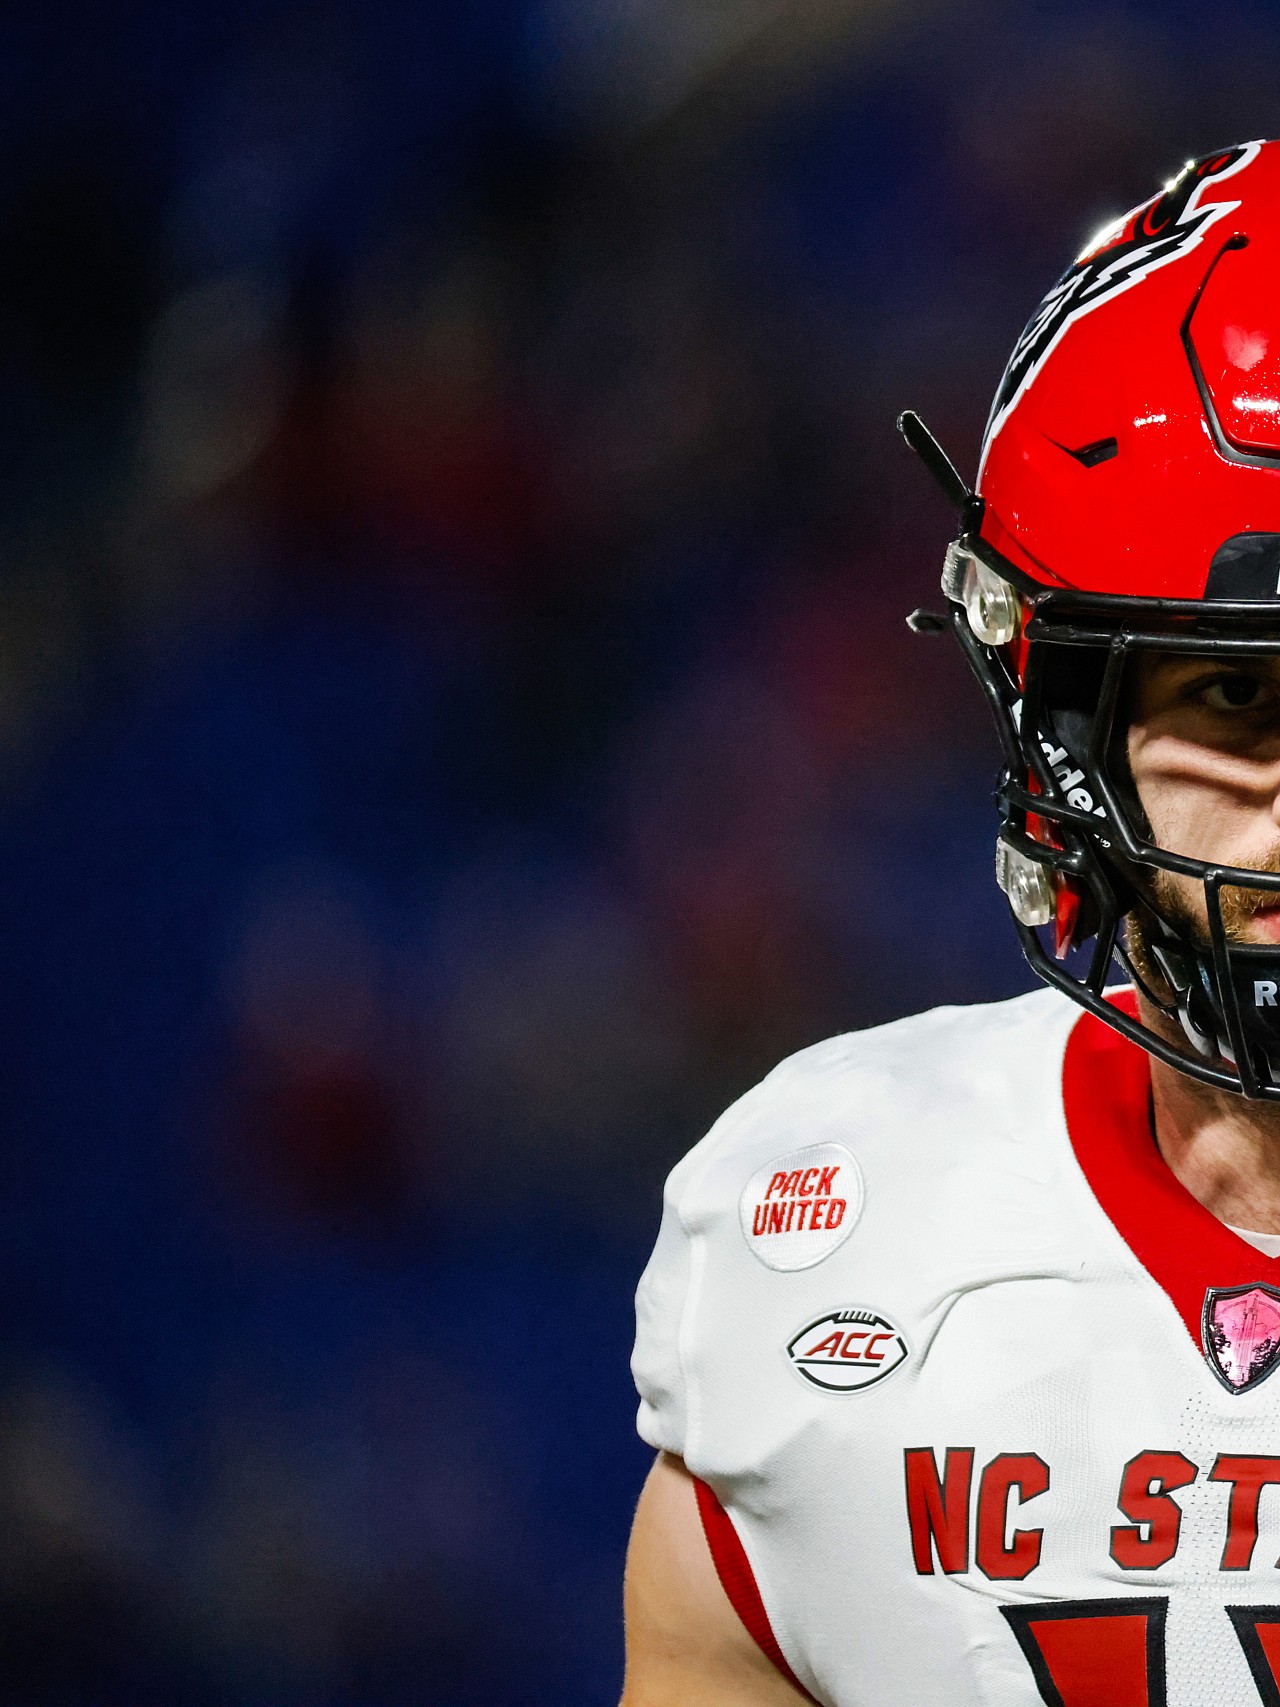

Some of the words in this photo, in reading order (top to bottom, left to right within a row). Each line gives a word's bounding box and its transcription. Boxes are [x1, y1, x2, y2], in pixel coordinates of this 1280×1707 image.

[765, 1166, 841, 1200] PACK
[753, 1198, 847, 1236] UNITED
[803, 1331, 897, 1361] ACC
[903, 1446, 1051, 1581] NC
